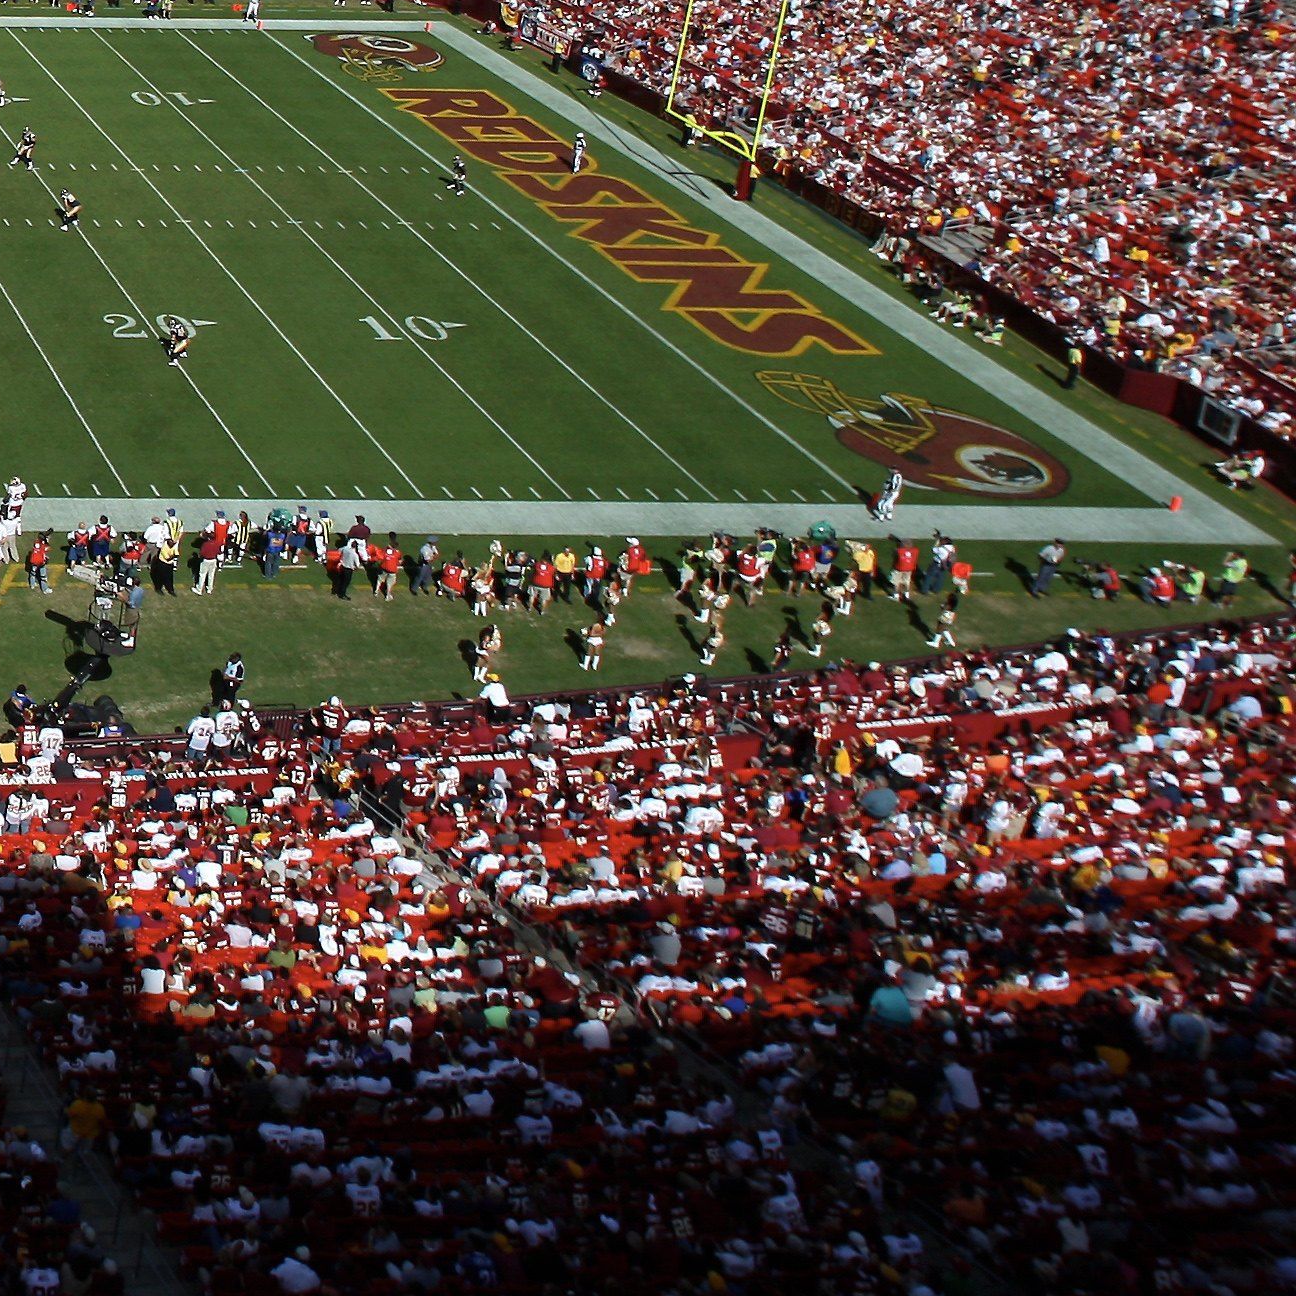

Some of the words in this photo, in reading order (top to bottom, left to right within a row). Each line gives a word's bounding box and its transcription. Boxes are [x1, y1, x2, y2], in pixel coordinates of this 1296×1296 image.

[380, 87, 882, 356] REDSKINS
[102, 314, 197, 339] 20
[358, 315, 447, 340] 10
